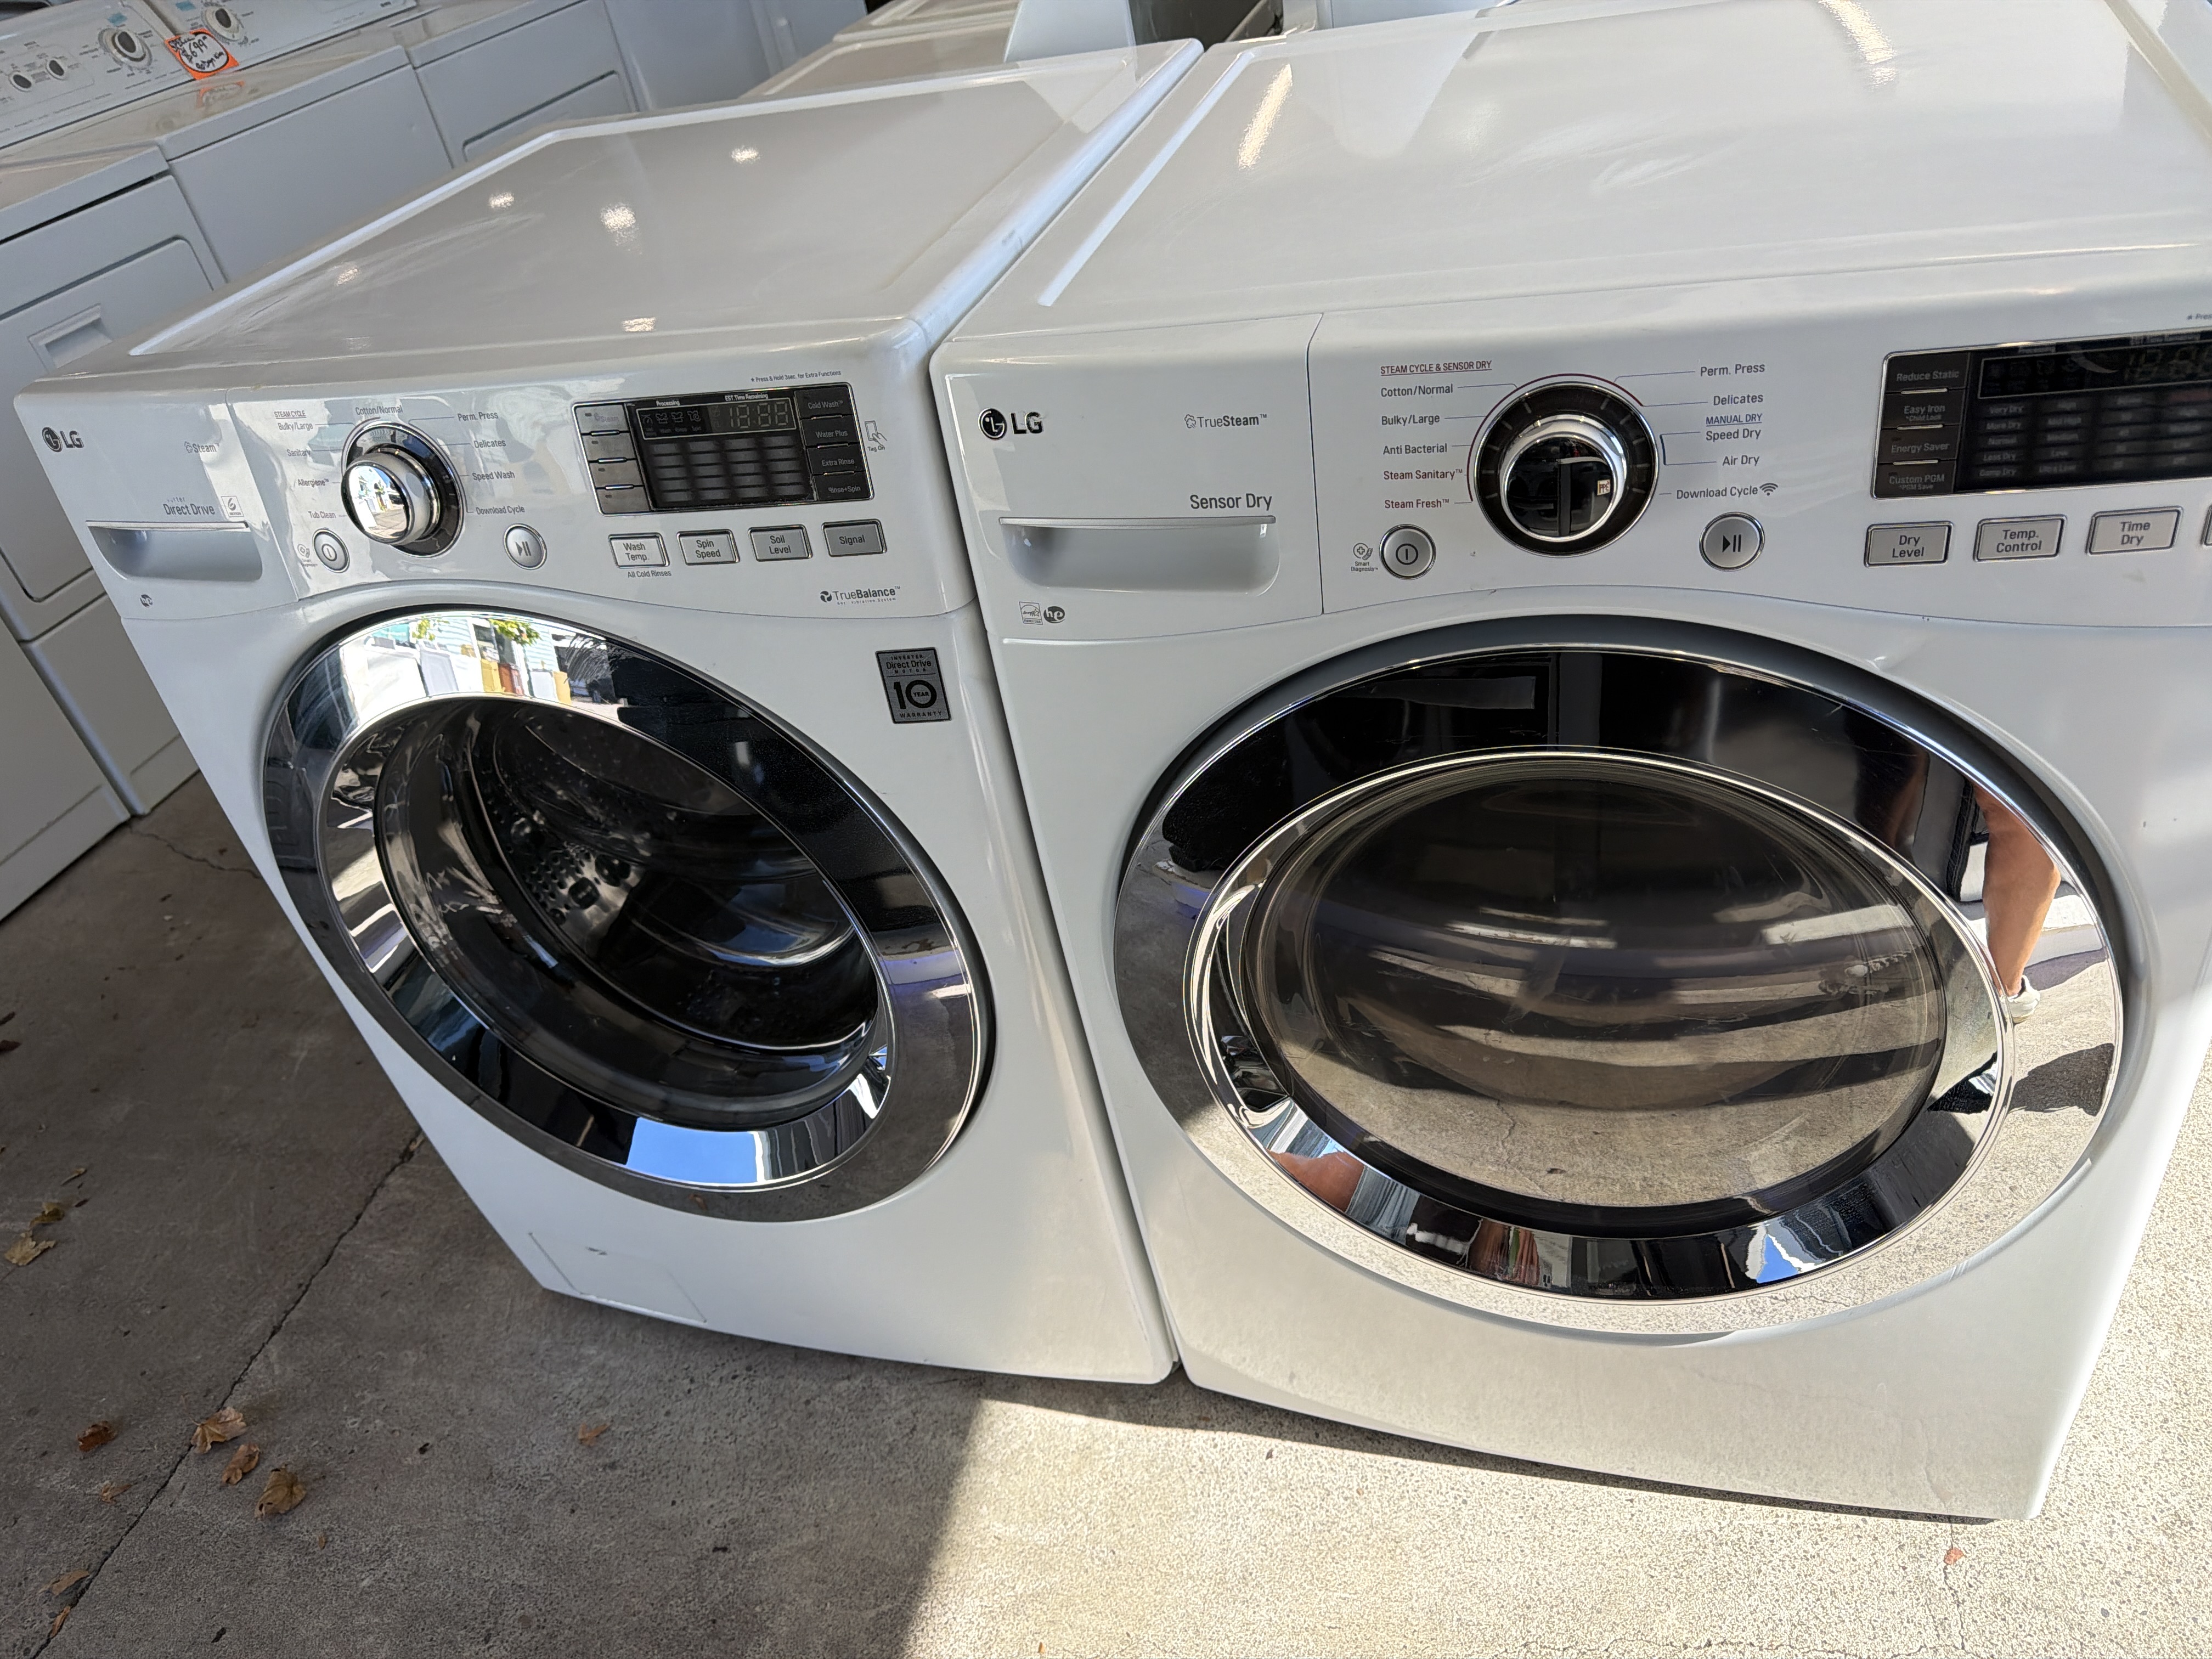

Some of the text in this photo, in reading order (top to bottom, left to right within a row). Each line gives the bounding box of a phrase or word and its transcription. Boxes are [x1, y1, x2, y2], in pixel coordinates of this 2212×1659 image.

[1381, 365, 1407, 374] STEAM
[1409, 364, 1434, 373] CYCLE
[1443, 362, 1474, 371] SENSOR
[1476, 360, 1492, 369] DRY
[1700, 364, 1765, 376] Perm. Press
[1897, 370, 1959, 381] Reduce Static
[1381, 383, 1453, 397] Cotton/Normal
[1713, 393, 1763, 405] Delicates
[356, 405, 403, 415] Cotton/Normal
[1904, 406, 1925, 414] Easy
[1009, 411, 1043, 434] LG
[1381, 414, 1440, 426] Bulky/Large
[1706, 413, 1762, 425] MANUAL DRY
[278, 423, 313, 431] Bulky/Large
[60, 431, 84, 448] LG
[1706, 428, 1761, 442] Speed Dry
[474, 440, 506, 448] Delicates
[1383, 443, 1447, 455] Anti Bacterial
[287, 449, 311, 457] Sanitary
[1723, 455, 1759, 466] Air Dry
[472, 471, 515, 482] Speed Wash
[1384, 471, 1413, 480] Steam
[1889, 474, 1944, 484] Custom PGM
[1677, 486, 1758, 499] Download Cycle
[1190, 493, 1272, 511] Sensor Dry
[1385, 500, 1414, 508] Steam
[163, 503, 215, 515] Direct Drive
[476, 505, 524, 515] Download Cycle
[2120, 521, 2150, 532] Time
[770, 535, 785, 544] Soil
[839, 534, 865, 545] Signal
[2002, 528, 2039, 541] Temp.
[2121, 534, 2143, 546] Dry
[623, 542, 646, 551] Wash
[696, 539, 715, 549] Spin
[1899, 535, 1920, 547] Dry
[1996, 540, 2041, 553] Control
[695, 549, 721, 559] Speed
[769, 545, 791, 554] Level
[1892, 547, 1924, 558] Level
[625, 552, 650, 562] Temp.
[886, 661, 910, 669] Direct
[893, 680, 937, 709] 10
